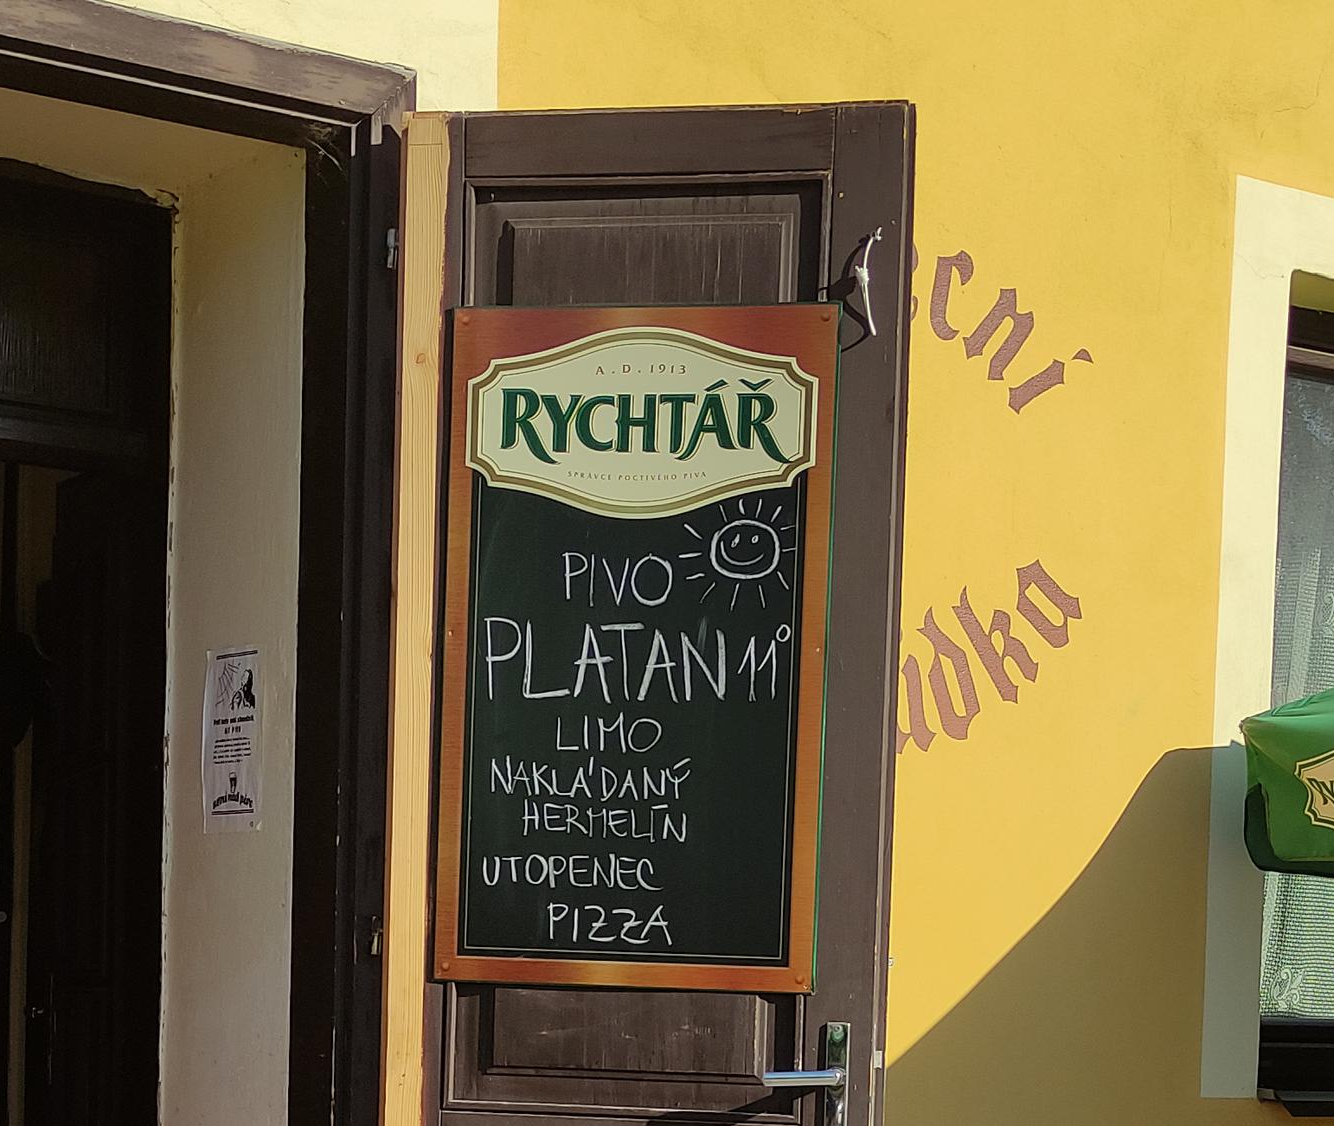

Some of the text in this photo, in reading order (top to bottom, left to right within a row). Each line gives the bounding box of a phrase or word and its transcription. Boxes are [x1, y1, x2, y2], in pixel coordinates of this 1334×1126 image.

[500, 378, 793, 464] RYCHTÁŘ
[567, 470, 707, 481] SPRÁVCE POCTIVÉHO PIVA
[562, 552, 673, 607] PIVO
[483, 617, 725, 703] PLATAN
[556, 712, 662, 753] LIMO
[490, 755, 692, 801] NAKLÁDANÝ
[522, 799, 687, 843] HERMELÍN
[482, 853, 664, 890] UTOPENEC
[547, 902, 673, 946] PIZZA
